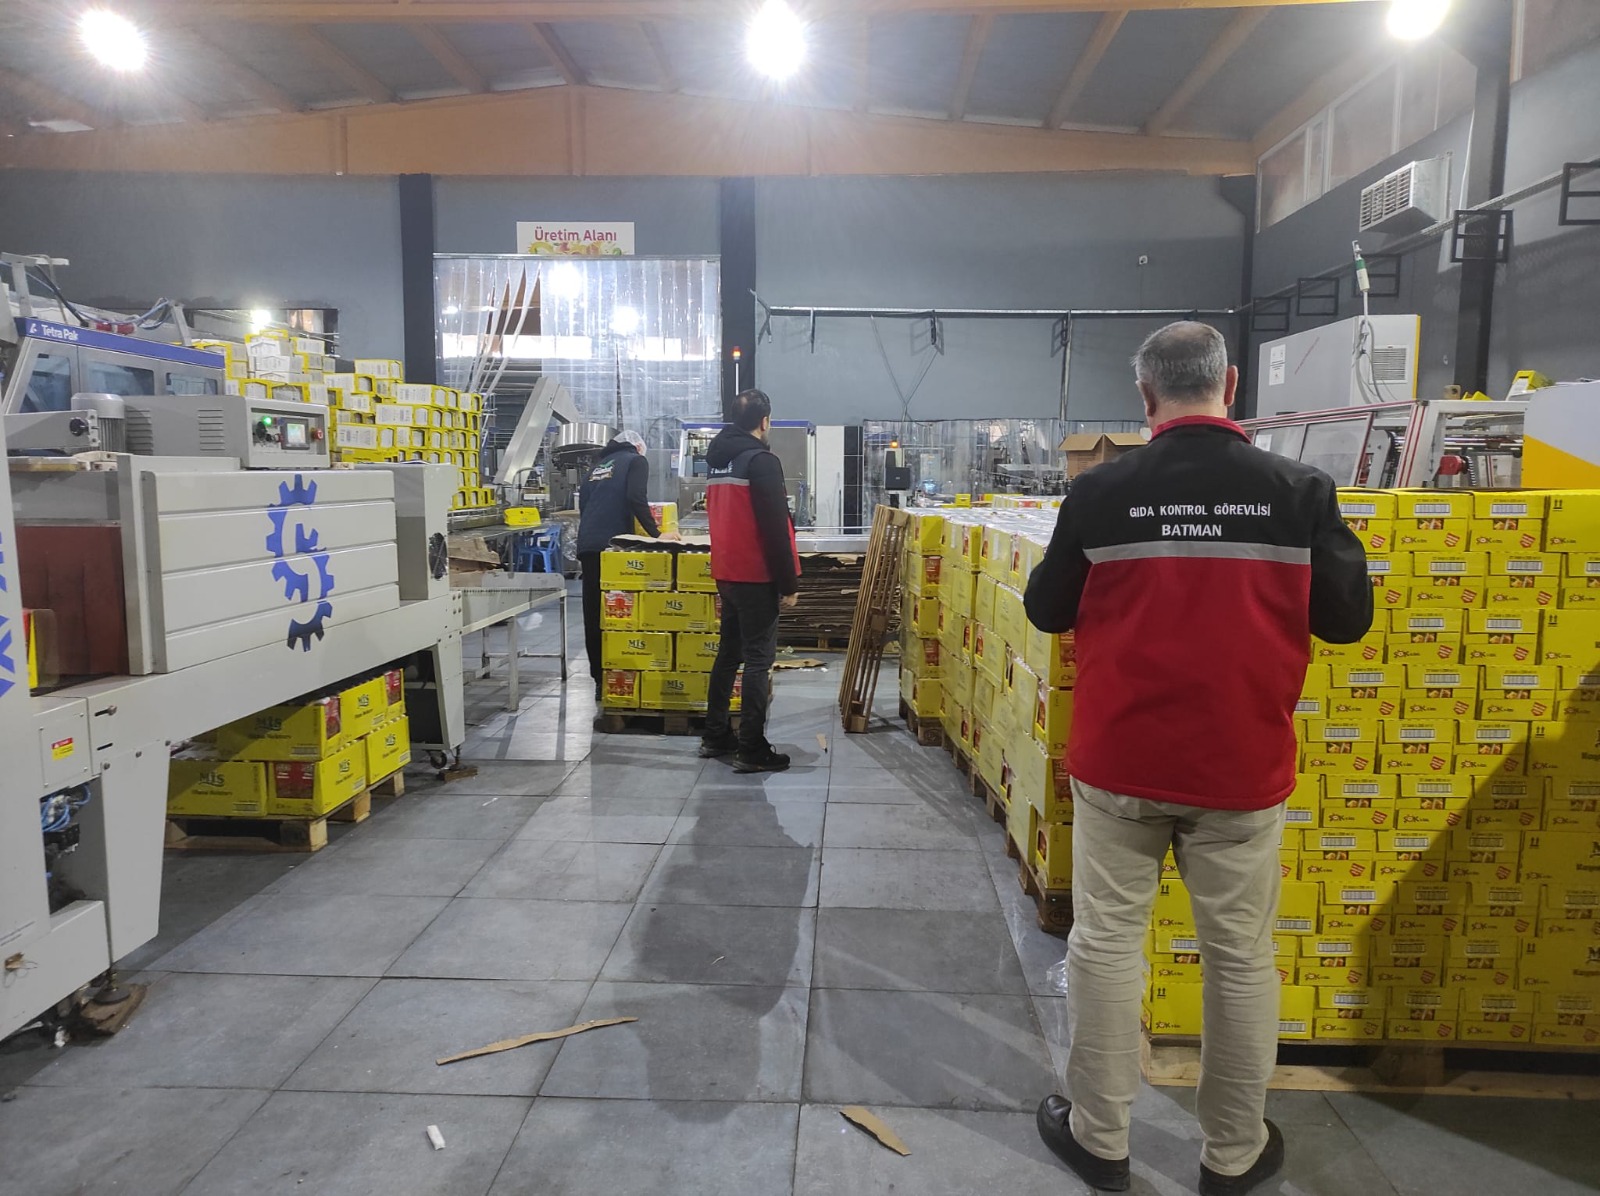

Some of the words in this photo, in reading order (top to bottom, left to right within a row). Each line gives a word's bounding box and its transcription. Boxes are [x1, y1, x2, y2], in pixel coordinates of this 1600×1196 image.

[534, 226, 579, 241] Üretim
[583, 229, 617, 241] Alanı
[41, 324, 62, 338] Tetra
[63, 328, 79, 341] Pak
[1129, 506, 1155, 518] GIDA
[1159, 504, 1208, 517] KONTROL
[1213, 502, 1271, 517] GÖREVLİSİ
[1161, 523, 1222, 537] BATMAN
